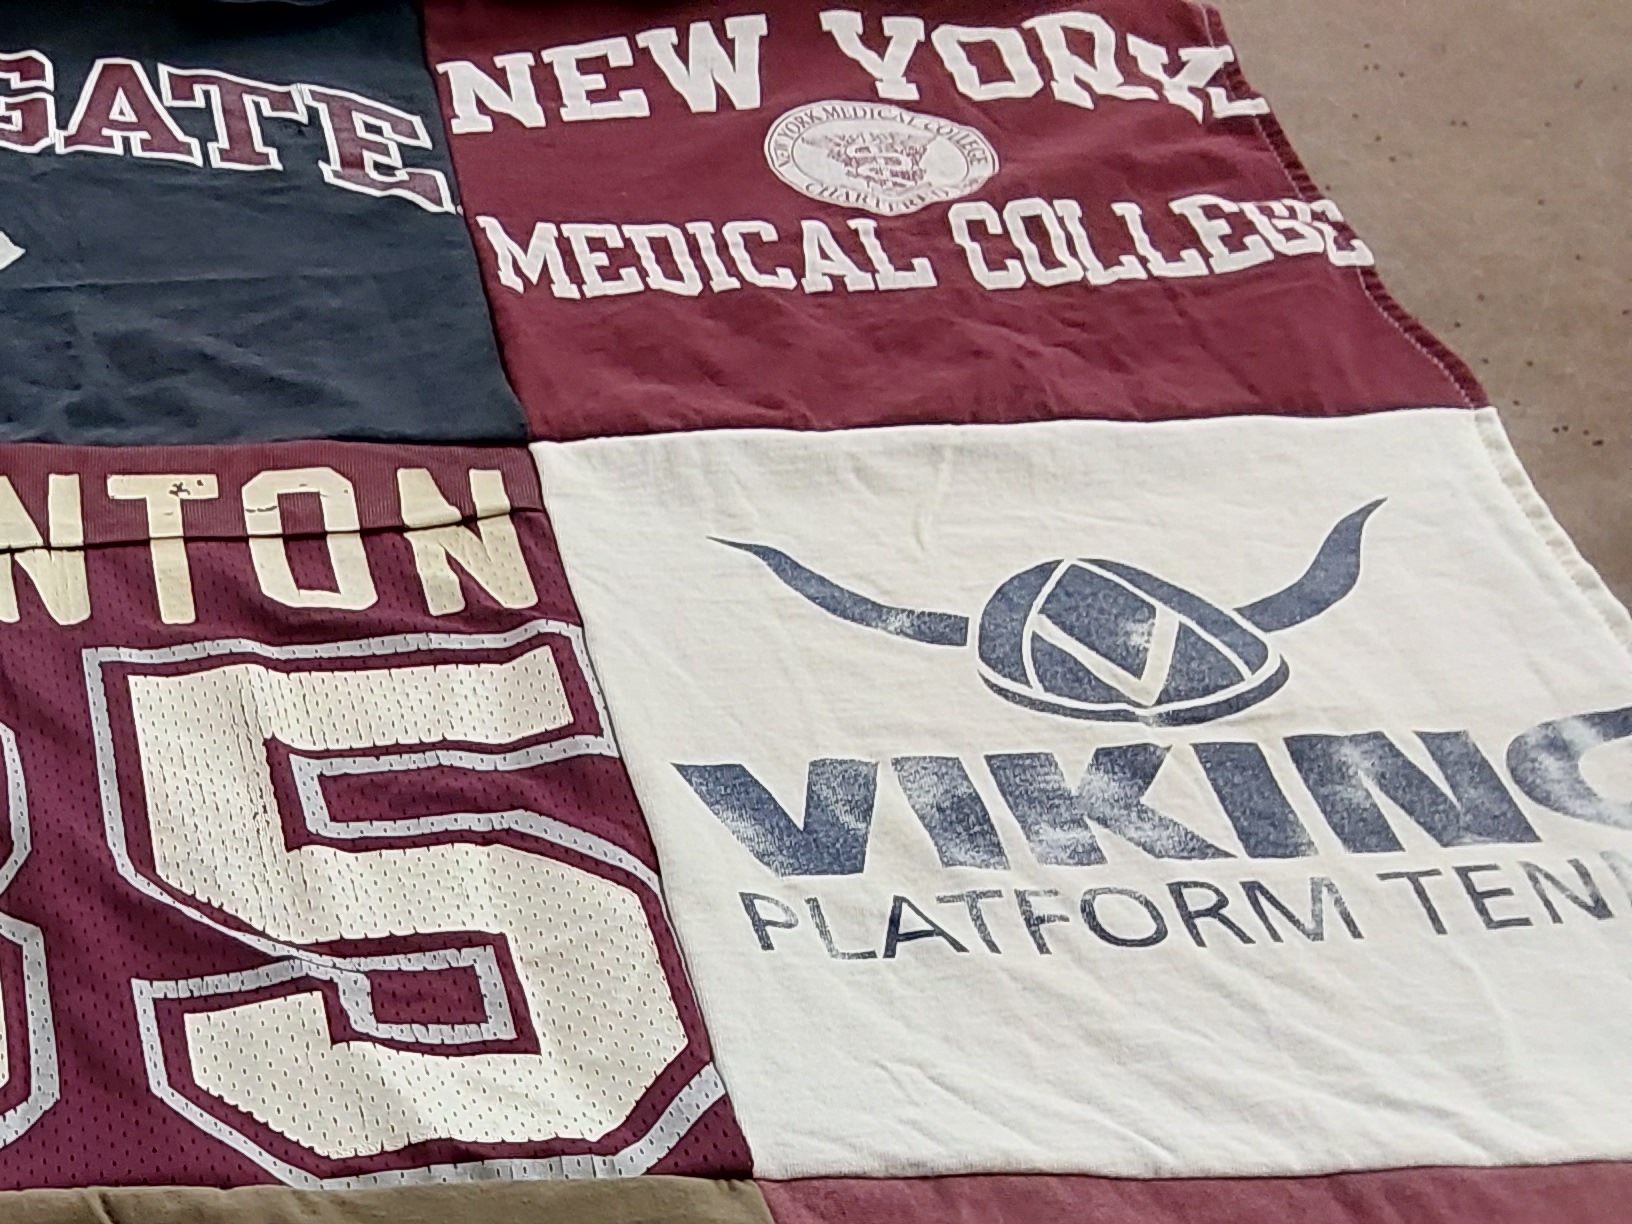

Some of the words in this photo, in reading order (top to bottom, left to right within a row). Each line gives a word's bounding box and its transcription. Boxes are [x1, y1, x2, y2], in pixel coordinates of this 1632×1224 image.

[436, 12, 767, 134] NEW
[820, 10, 1270, 124] YORK
[477, 214, 937, 299] MEDICAL
[951, 194, 1375, 291] COLLEGE
[738, 875, 1364, 960] PLATFORM
